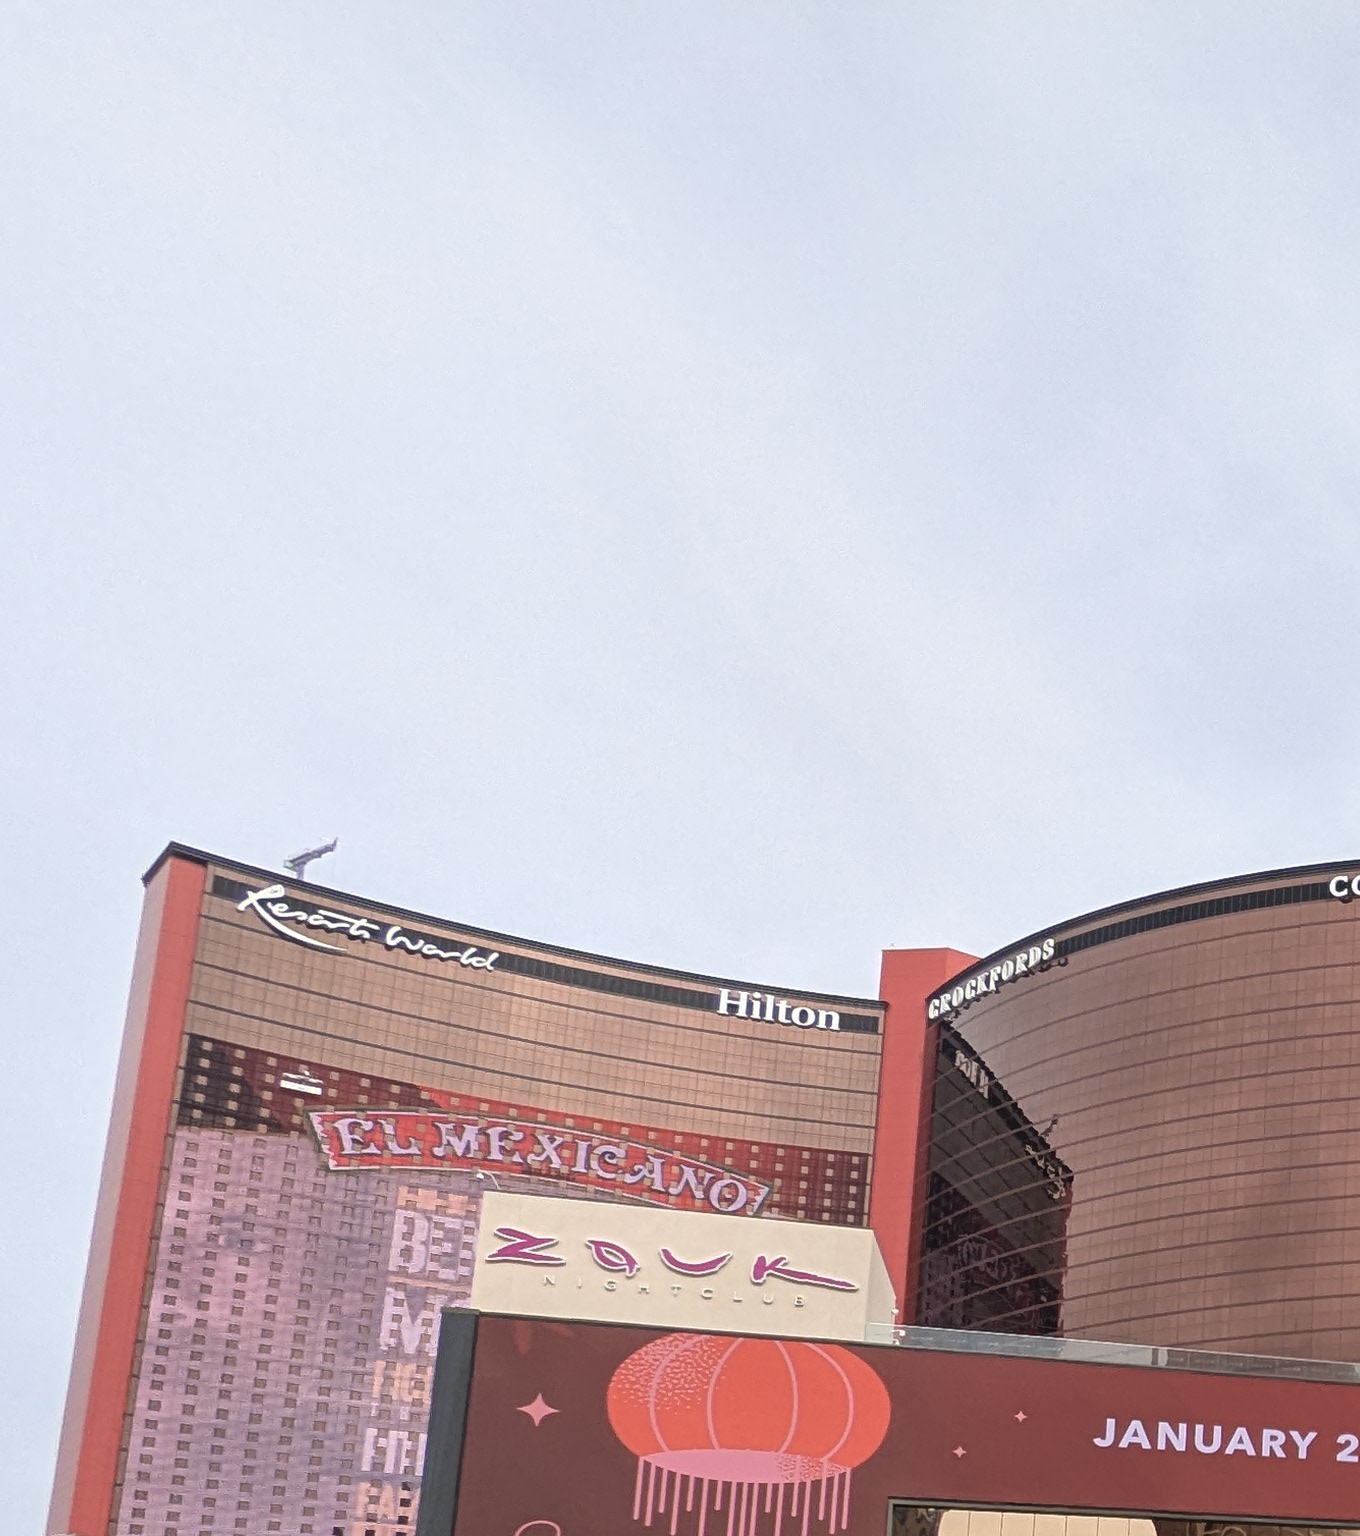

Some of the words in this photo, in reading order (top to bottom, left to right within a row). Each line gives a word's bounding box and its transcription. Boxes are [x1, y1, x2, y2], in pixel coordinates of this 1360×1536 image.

[237, 884, 380, 951] Resorts
[386, 926, 499, 970] World
[717, 988, 841, 1031] Hilton
[928, 938, 1055, 1020] CROCKFORDS
[333, 1118, 421, 1156] EL
[433, 1121, 748, 1213] MEXICANO
[485, 1227, 859, 1291] ZOUK
[542, 1274, 806, 1308] NIGHTCLUB
[1093, 1418, 1317, 1460] JANUARY
